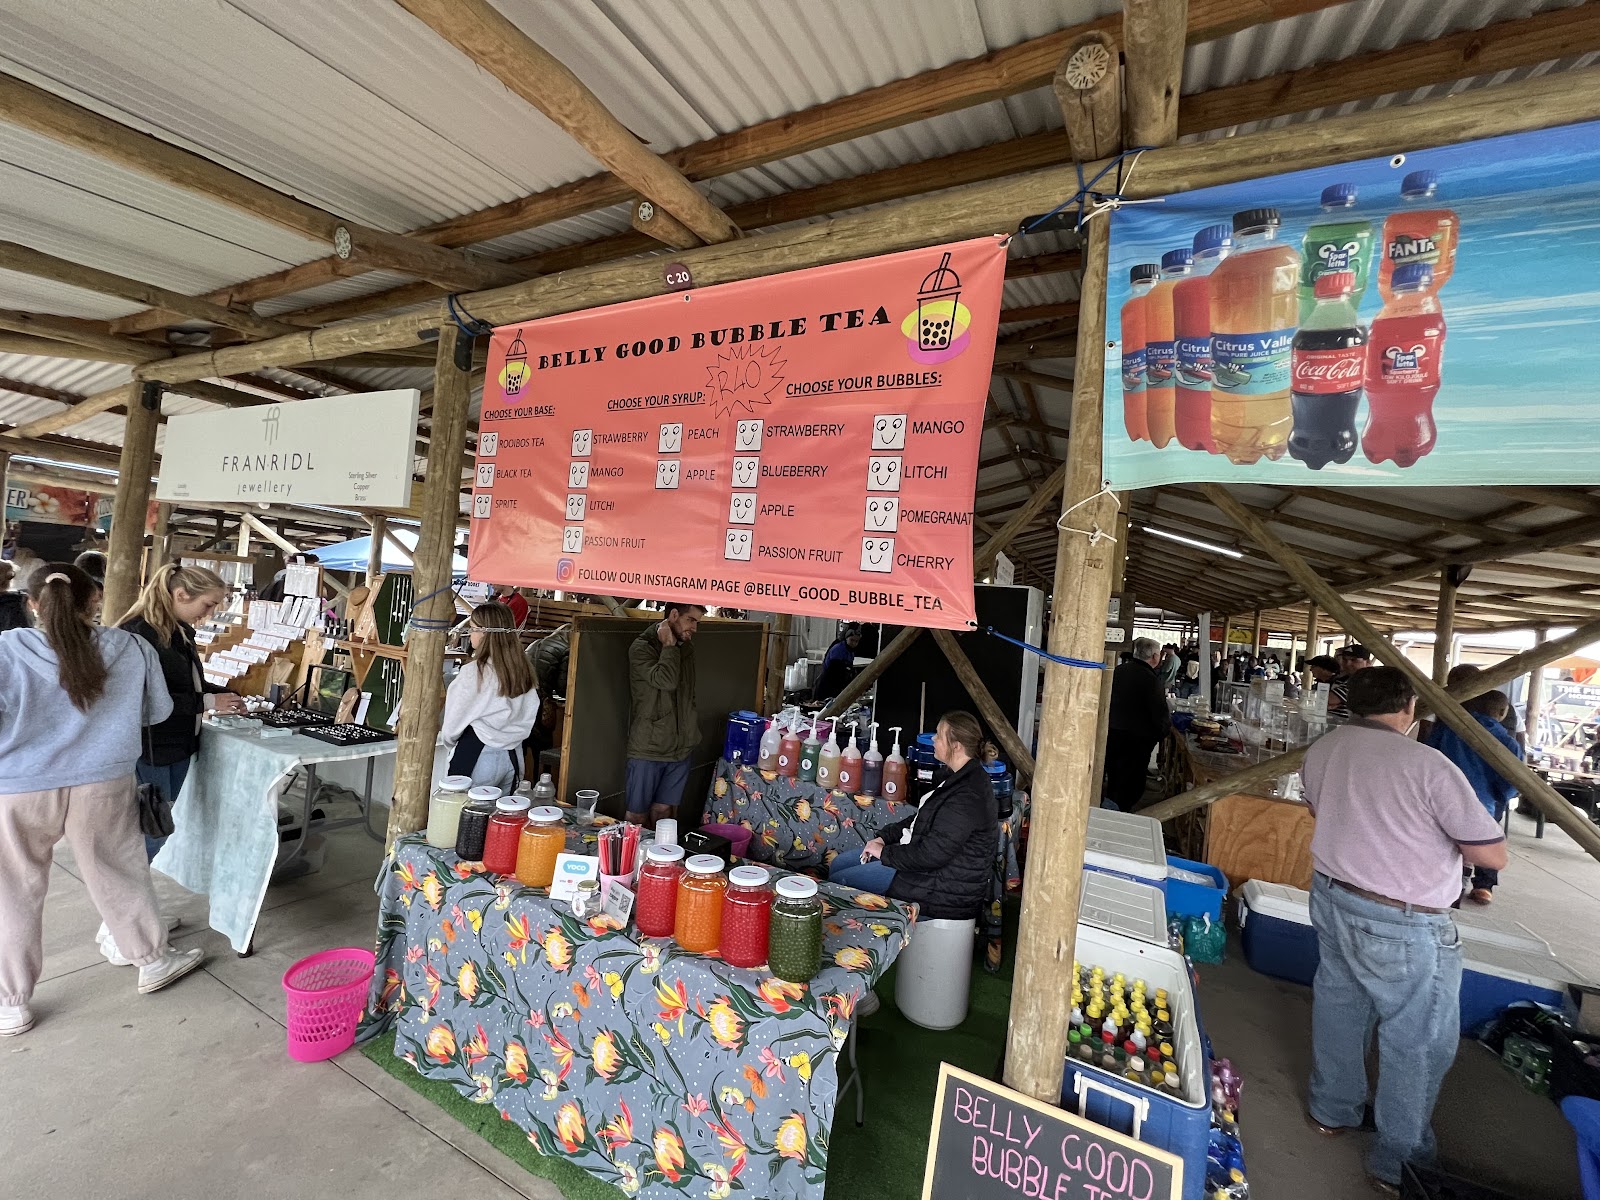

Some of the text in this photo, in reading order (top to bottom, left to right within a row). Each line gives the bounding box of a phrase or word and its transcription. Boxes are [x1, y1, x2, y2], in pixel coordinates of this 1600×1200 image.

[666, 271, 689, 285] C 20
[538, 306, 891, 370] BELLY GOOD BUBBLE TEA
[1215, 335, 1293, 351] Citrus Valle
[1147, 347, 1173, 355] Citrus
[1181, 343, 1210, 353] Citru
[1296, 357, 1362, 380] Coca-Cola
[718, 360, 761, 400] R40
[786, 371, 943, 395] CHOOSE YOUR BUBBLES:
[607, 391, 706, 410] CHOOSE YOUR SYRUP:
[484, 405, 556, 419] CHOOSE YOUR BASE:
[687, 428, 720, 440] PEACH
[766, 424, 845, 438] STRAWBERRY
[912, 421, 965, 434] MANGO
[499, 437, 544, 449] ROOIBOS TEA
[593, 431, 648, 445] STRAWBERRY
[348, 471, 377, 481] Sterling Silver
[496, 468, 532, 479] BLACK TEA
[590, 467, 624, 477] MANGO
[686, 469, 716, 481] APPLE
[761, 465, 828, 477] BLUEBERRY
[904, 465, 948, 479] LITCHI
[237, 480, 292, 496] jewellery
[353, 483, 370, 491] Copper
[354, 493, 367, 501] Brass
[495, 499, 517, 509] SPRITE
[590, 500, 615, 511] LITCHI
[759, 504, 795, 517] APPLE
[900, 509, 974, 526] POMEGRANAT
[584, 535, 646, 549] PASSION FRUIT
[758, 545, 843, 563] PASSION FRUIT
[896, 554, 954, 570] CHERRY
[578, 568, 943, 611] FOLLOW OUR INSTAGRAM PAGE @BELLY_GOOD_BUBBLE_TEA
[567, 863, 587, 872] YOCO
[954, 1087, 1154, 1200] BELLY GOOD
[972, 1135, 1072, 1200] BUBBLE
